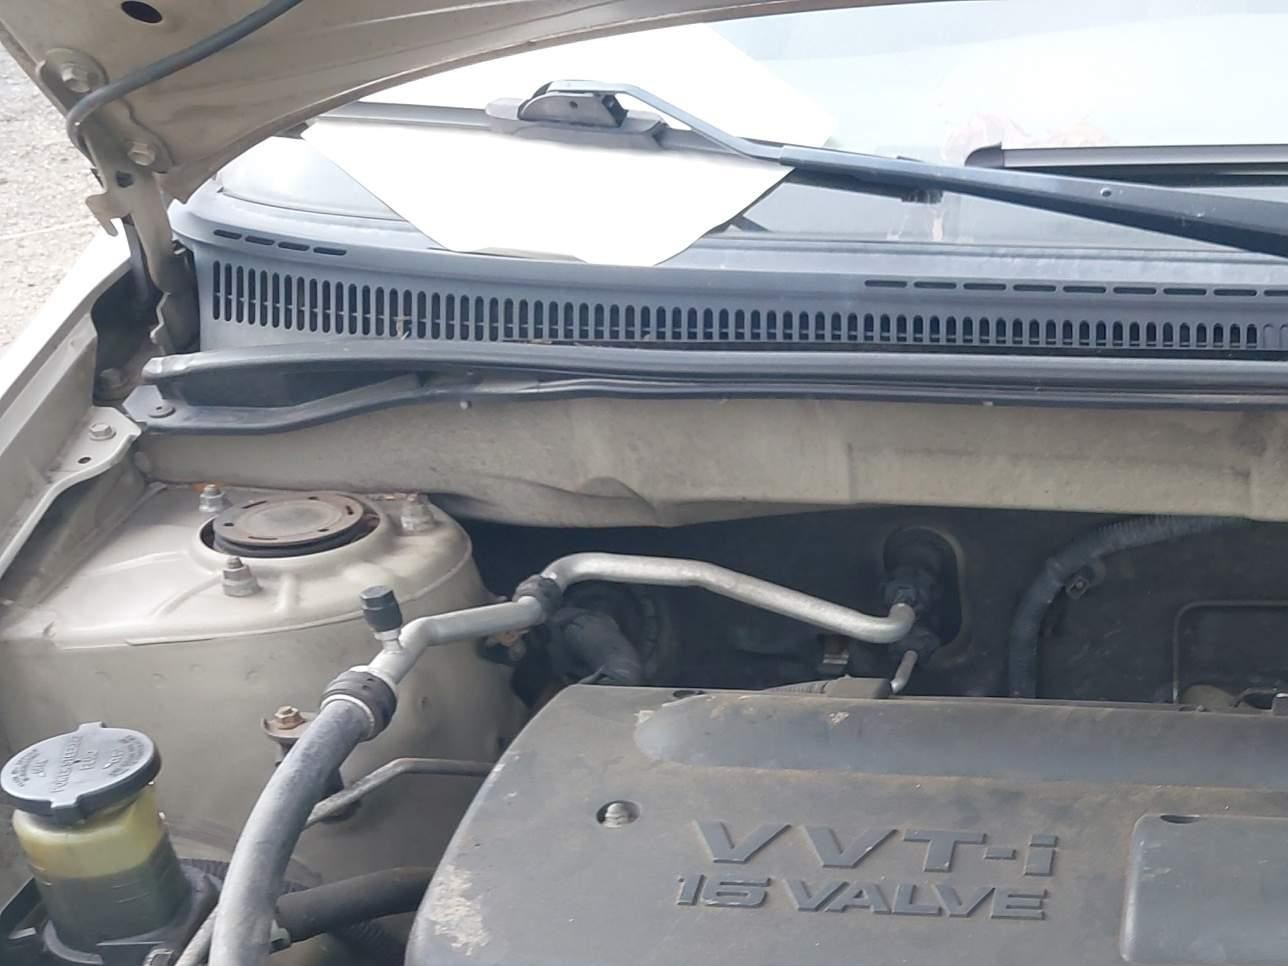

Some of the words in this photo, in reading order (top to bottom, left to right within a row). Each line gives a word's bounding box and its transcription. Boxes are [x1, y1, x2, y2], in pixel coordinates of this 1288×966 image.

[692, 820, 1060, 876] VVT-i
[674, 872, 771, 909] 16
[783, 878, 1050, 922] VALVE
